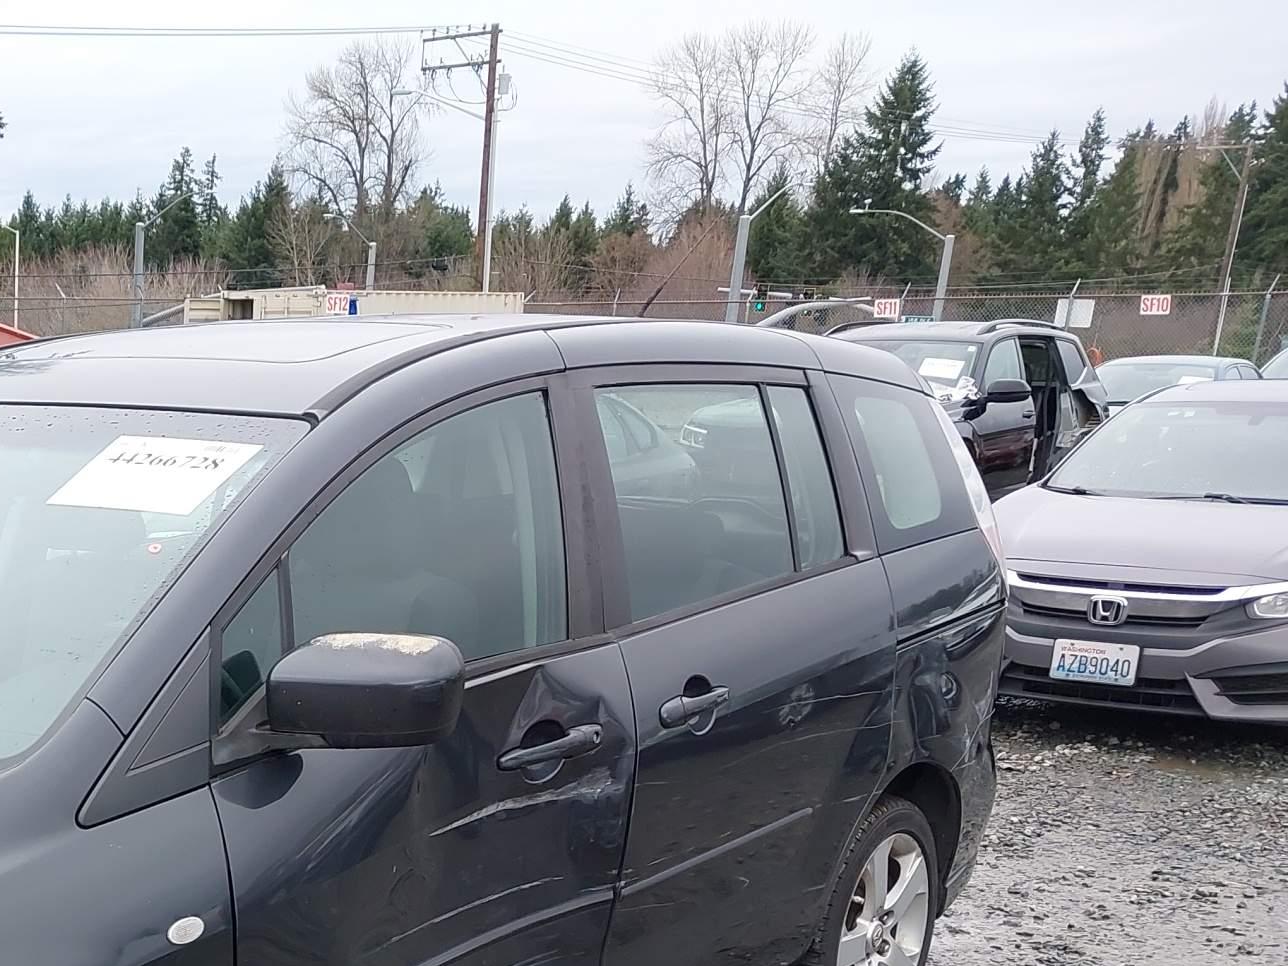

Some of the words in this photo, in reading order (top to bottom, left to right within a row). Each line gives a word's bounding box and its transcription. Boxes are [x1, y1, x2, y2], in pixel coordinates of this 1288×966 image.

[327, 296, 348, 312] SF12
[876, 301, 898, 315] SF11
[1142, 297, 1169, 312] SF10
[107, 452, 225, 470] 44266728
[1056, 653, 1131, 678] AZB9040
